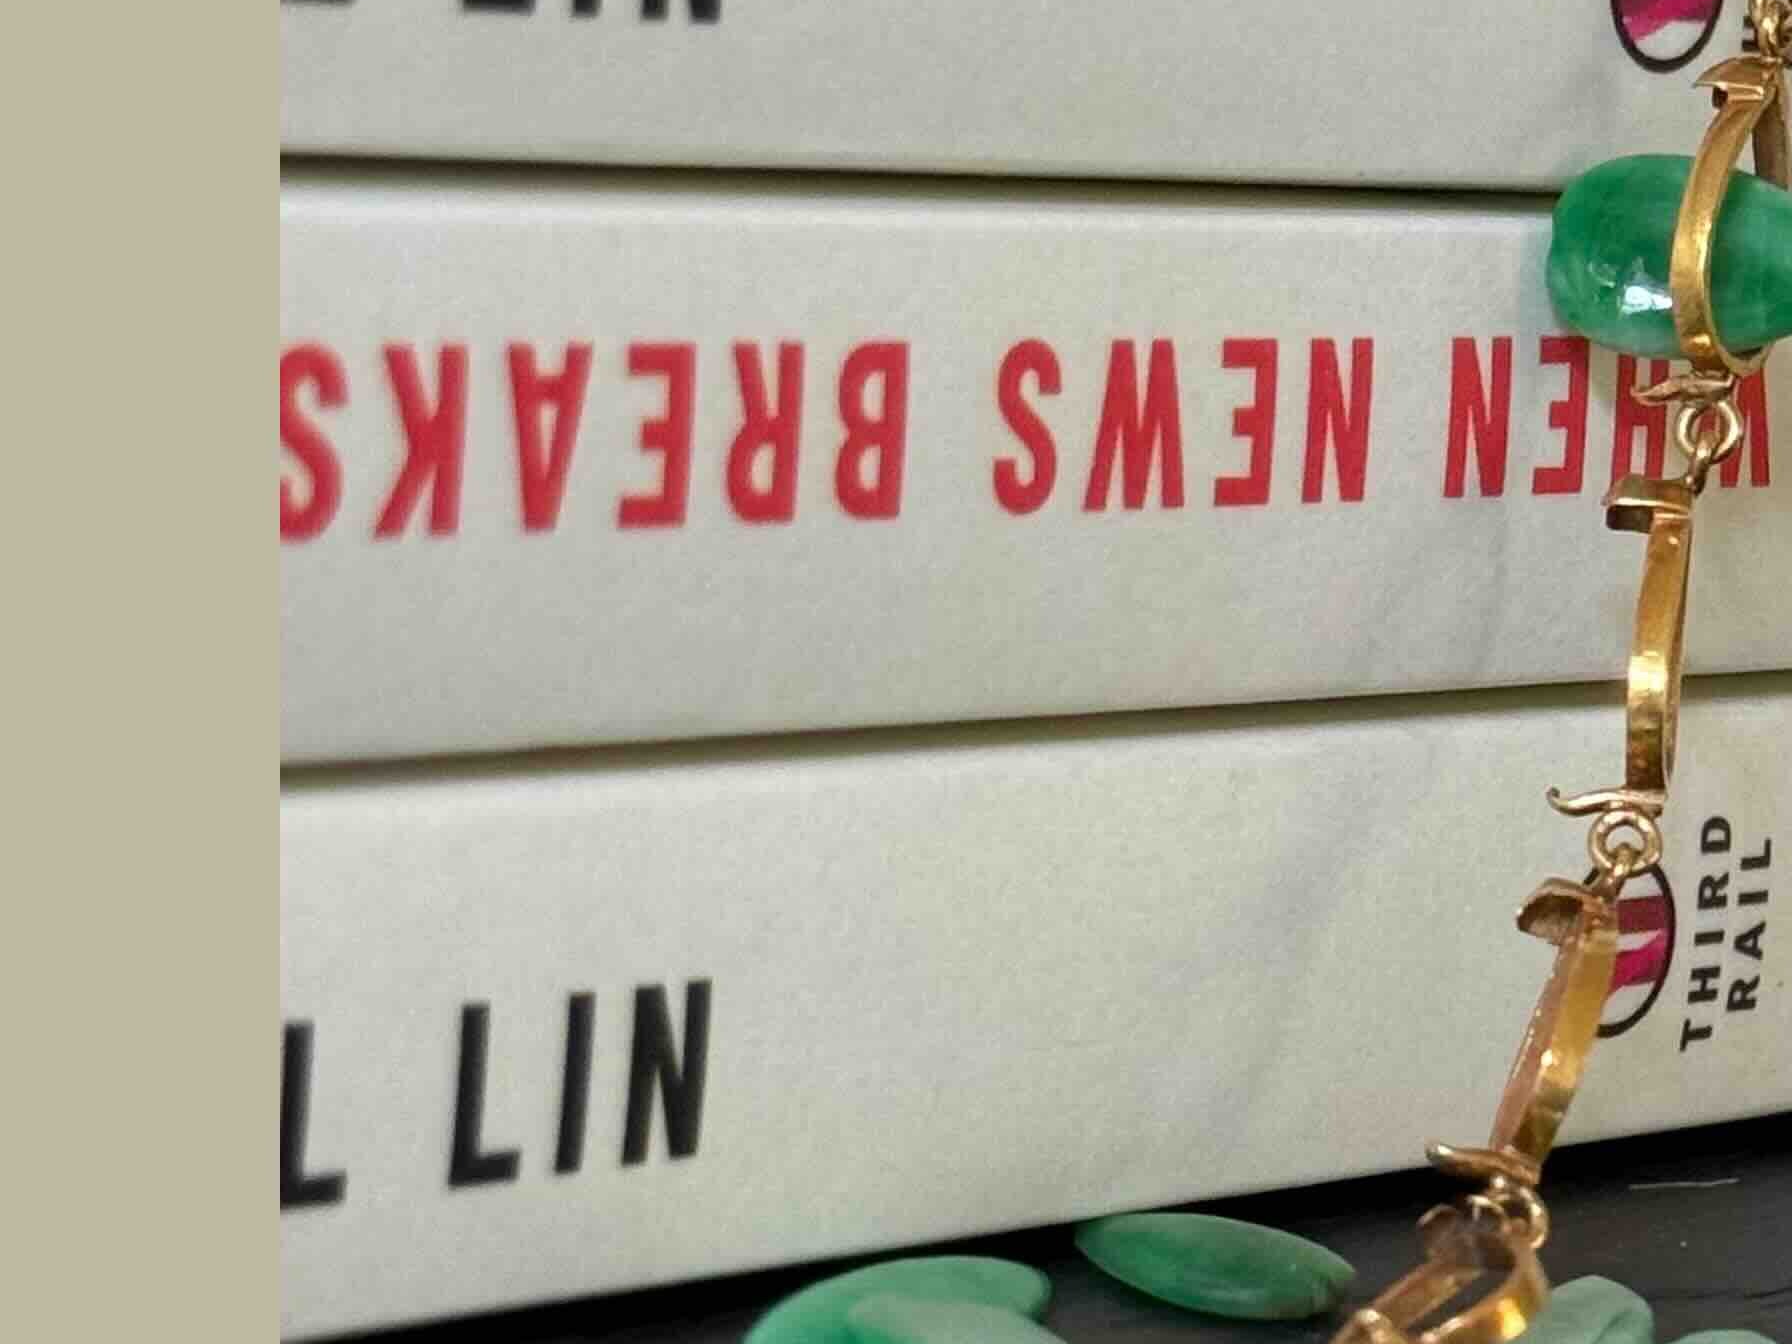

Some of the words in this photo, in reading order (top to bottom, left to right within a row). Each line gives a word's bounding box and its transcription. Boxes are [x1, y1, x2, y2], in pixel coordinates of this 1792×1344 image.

[280, 339, 910, 544] BREAKS
[991, 335, 1376, 515] NEWS
[1679, 815, 1733, 1053] THIRD
[1725, 836, 1773, 1013] RAIL
[446, 979, 713, 1193] LIN
